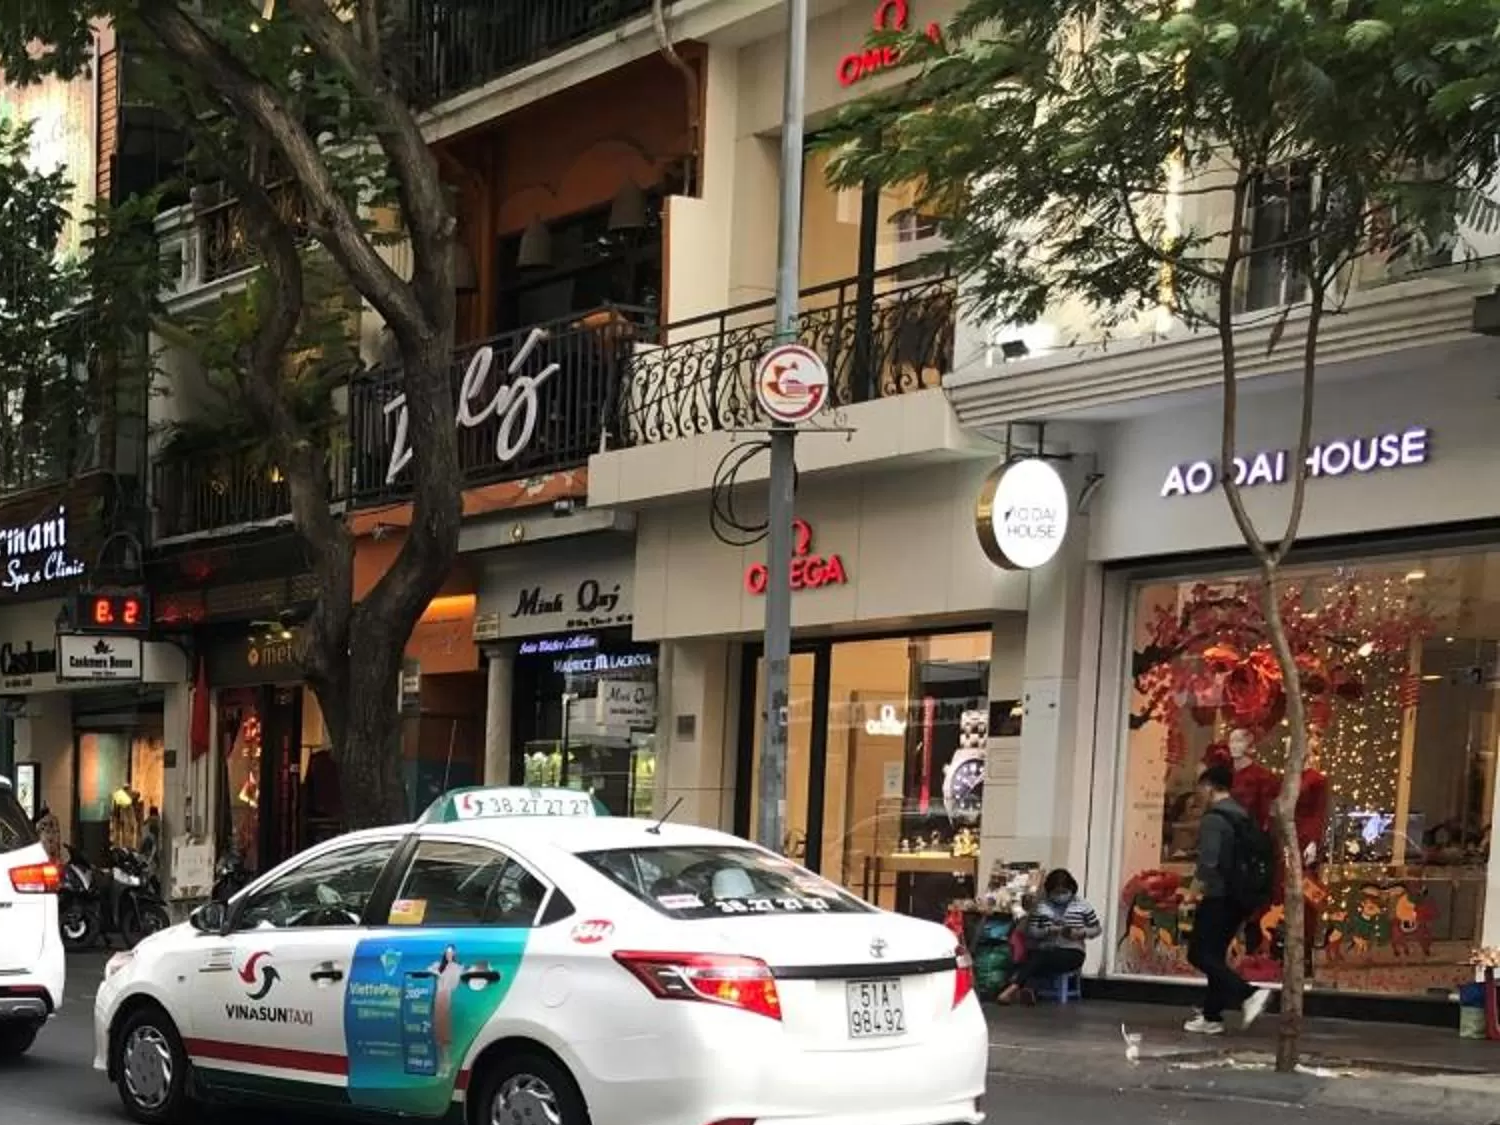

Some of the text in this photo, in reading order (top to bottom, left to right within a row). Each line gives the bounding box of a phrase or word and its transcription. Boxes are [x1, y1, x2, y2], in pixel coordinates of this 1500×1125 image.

[836, 22, 940, 88] OMEA
[1161, 461, 1213, 496] AO
[1008, 524, 1056, 539] HOUSE
[2, 559, 30, 592] Spa
[43, 550, 85, 580] Clinic
[744, 554, 846, 595] OEGA
[510, 586, 564, 618] Minh
[861, 983, 890, 1007] 51A
